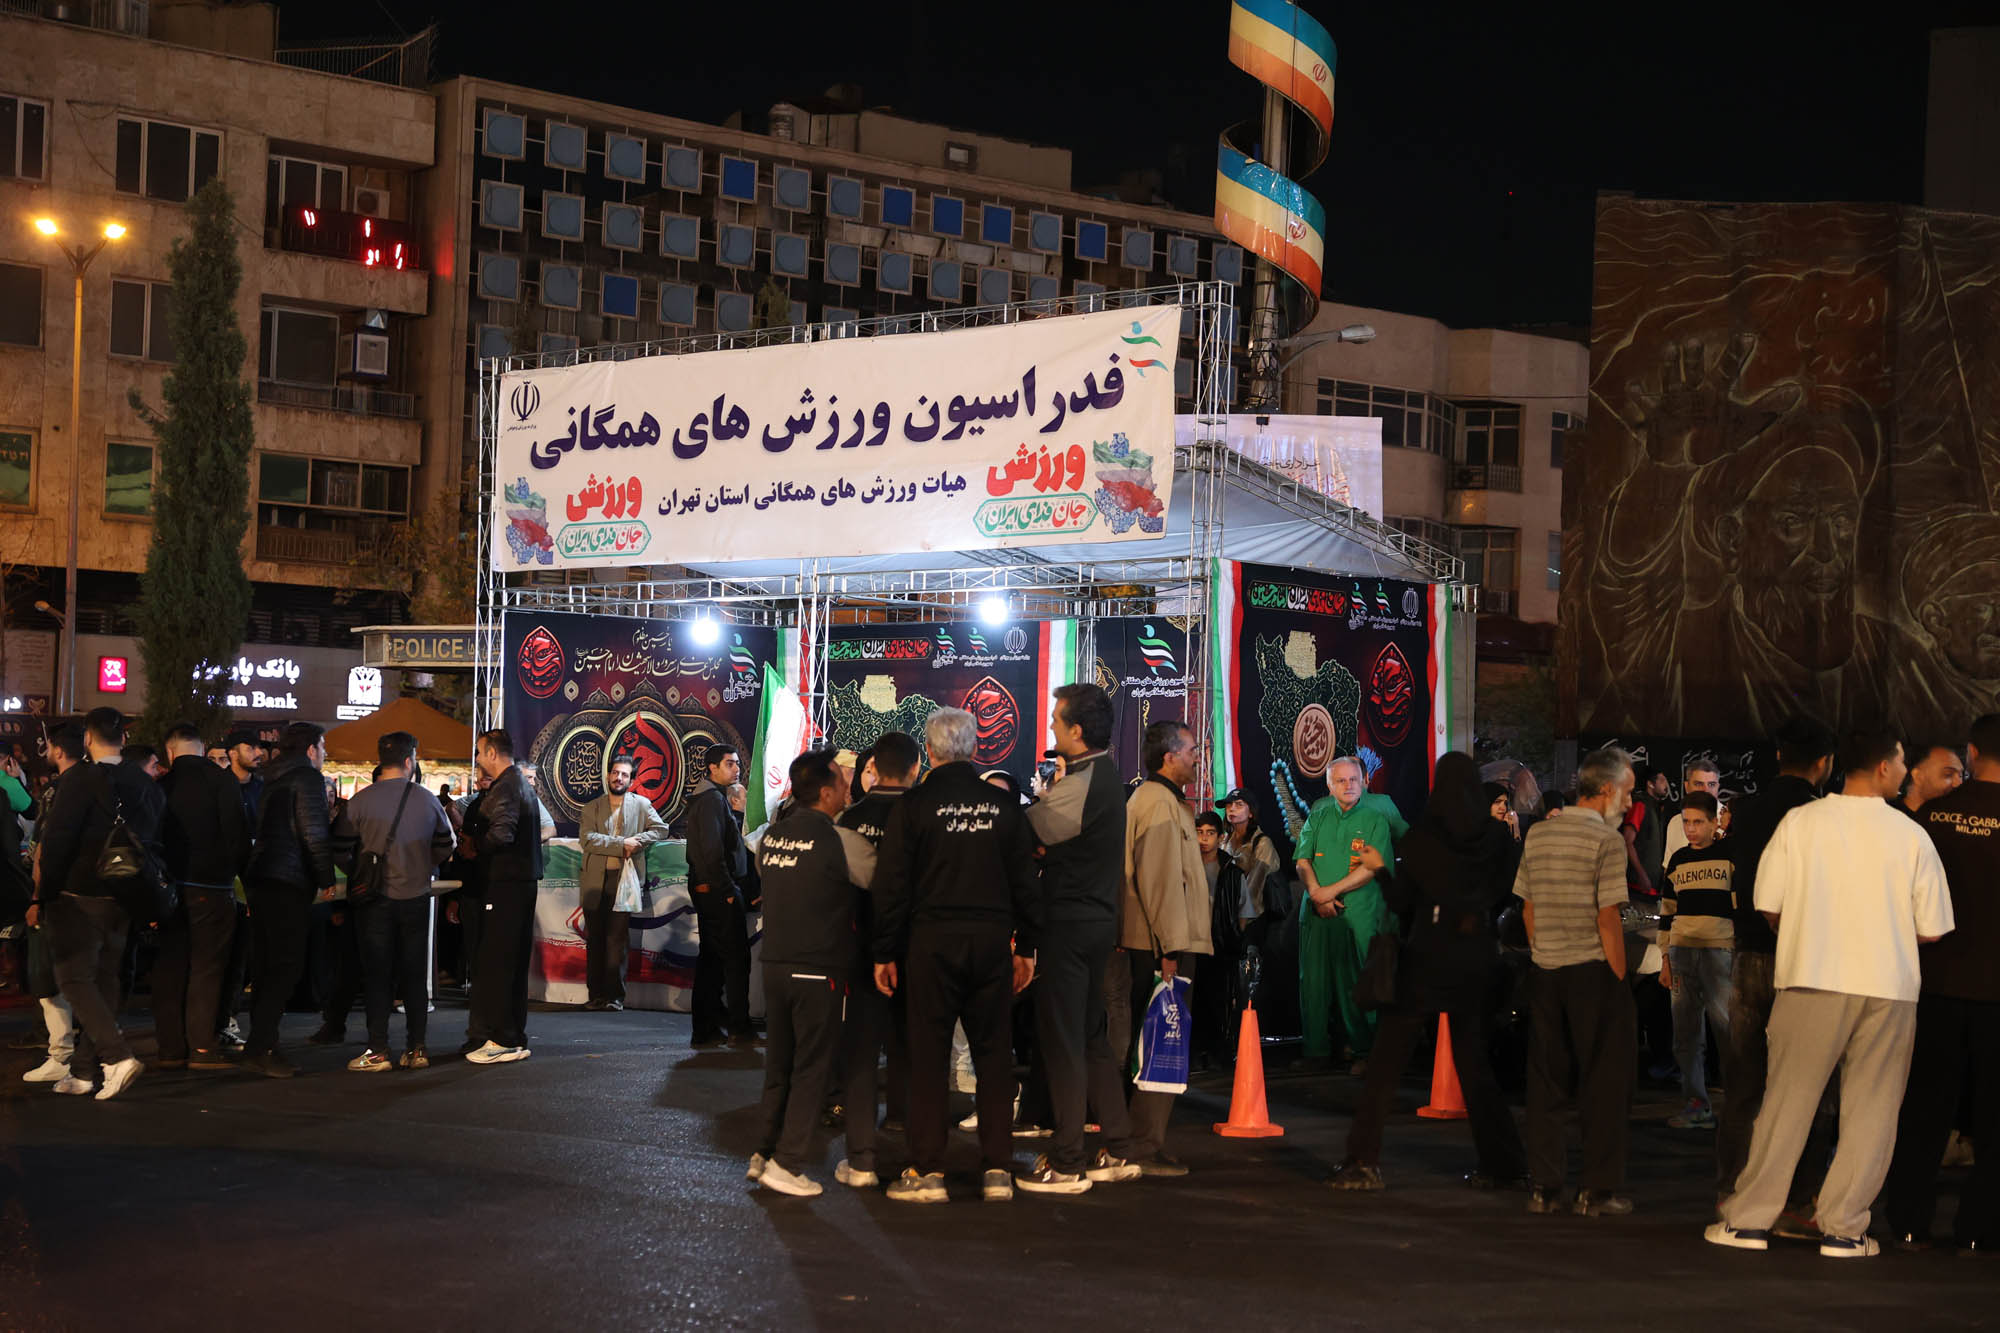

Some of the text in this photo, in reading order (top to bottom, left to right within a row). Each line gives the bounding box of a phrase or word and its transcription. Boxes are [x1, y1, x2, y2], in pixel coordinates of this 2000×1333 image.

[529, 352, 1125, 470] فدراسیون ورزش های همگانی
[986, 442, 1087, 497] ورزش
[565, 472, 644, 522] ورزش
[657, 469, 968, 516] هیات ورزش های همگانی استان تهران
[984, 500, 1087, 533] جان فدای ایران
[564, 524, 643, 554] جان فدای ایران
[393, 638, 464, 659] POLICE
[256, 657, 300, 685] بانک
[251, 690, 298, 710] Bank
[946, 818, 993, 833] استان تهران
[1930, 811, 2000, 829] DOLCE & GABB
[1955, 824, 1992, 837] MILANO
[1674, 867, 1728, 886] ALENCIAGA
